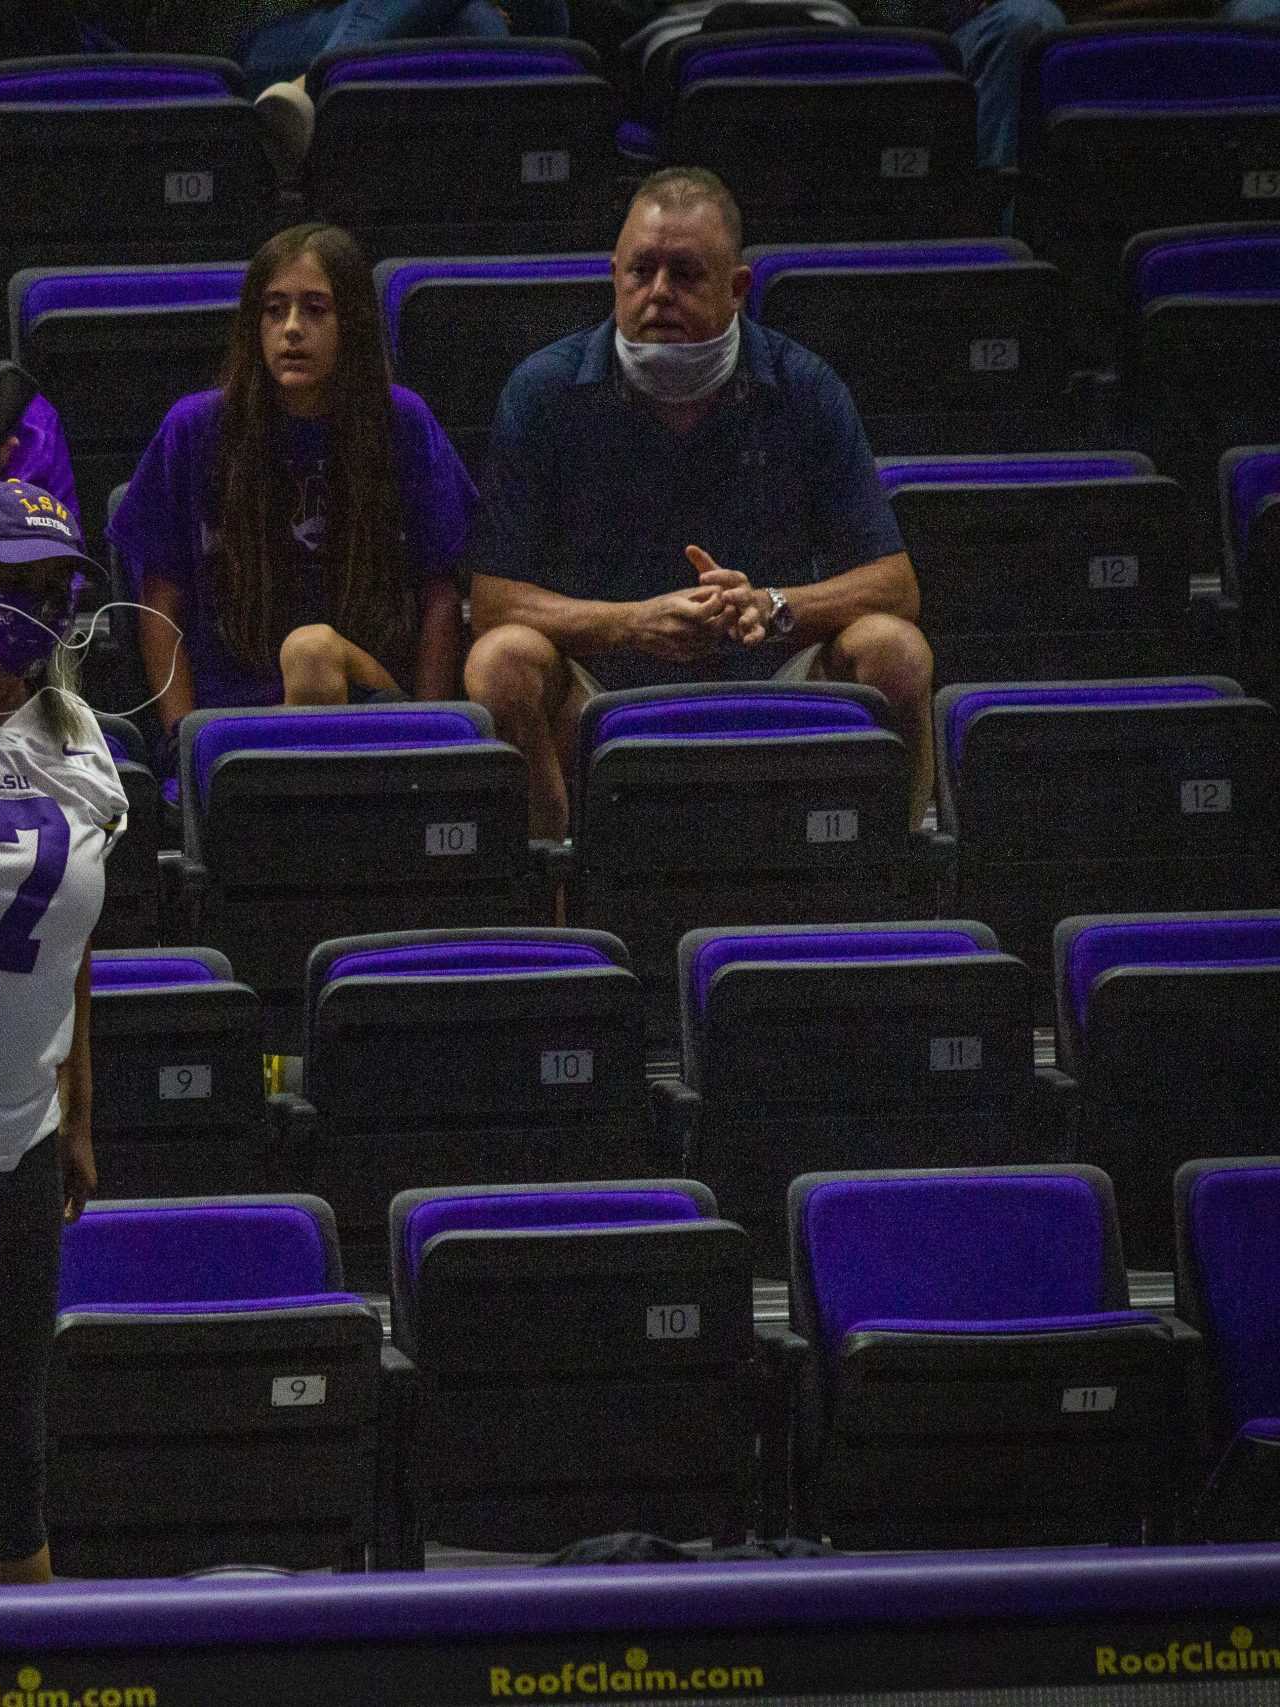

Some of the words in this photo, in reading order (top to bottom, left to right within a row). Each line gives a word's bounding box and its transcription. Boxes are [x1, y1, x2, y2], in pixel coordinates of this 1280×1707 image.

[538, 156, 554, 177] 11
[175, 175, 201, 198] 10
[983, 343, 1008, 367] 12
[19, 496, 68, 520] LSU
[1102, 559, 1126, 583] 12
[1194, 783, 1219, 808] 12
[439, 826, 464, 850] 10
[825, 814, 840, 838] 11
[948, 1041, 964, 1066] 11
[553, 1054, 579, 1079] 10
[177, 1069, 193, 1094] 9
[660, 1309, 686, 1334] 10
[290, 1379, 307, 1401] 9
[1082, 1390, 1097, 1409] 11
[488, 1647, 767, 1697] RoofClaim.com
